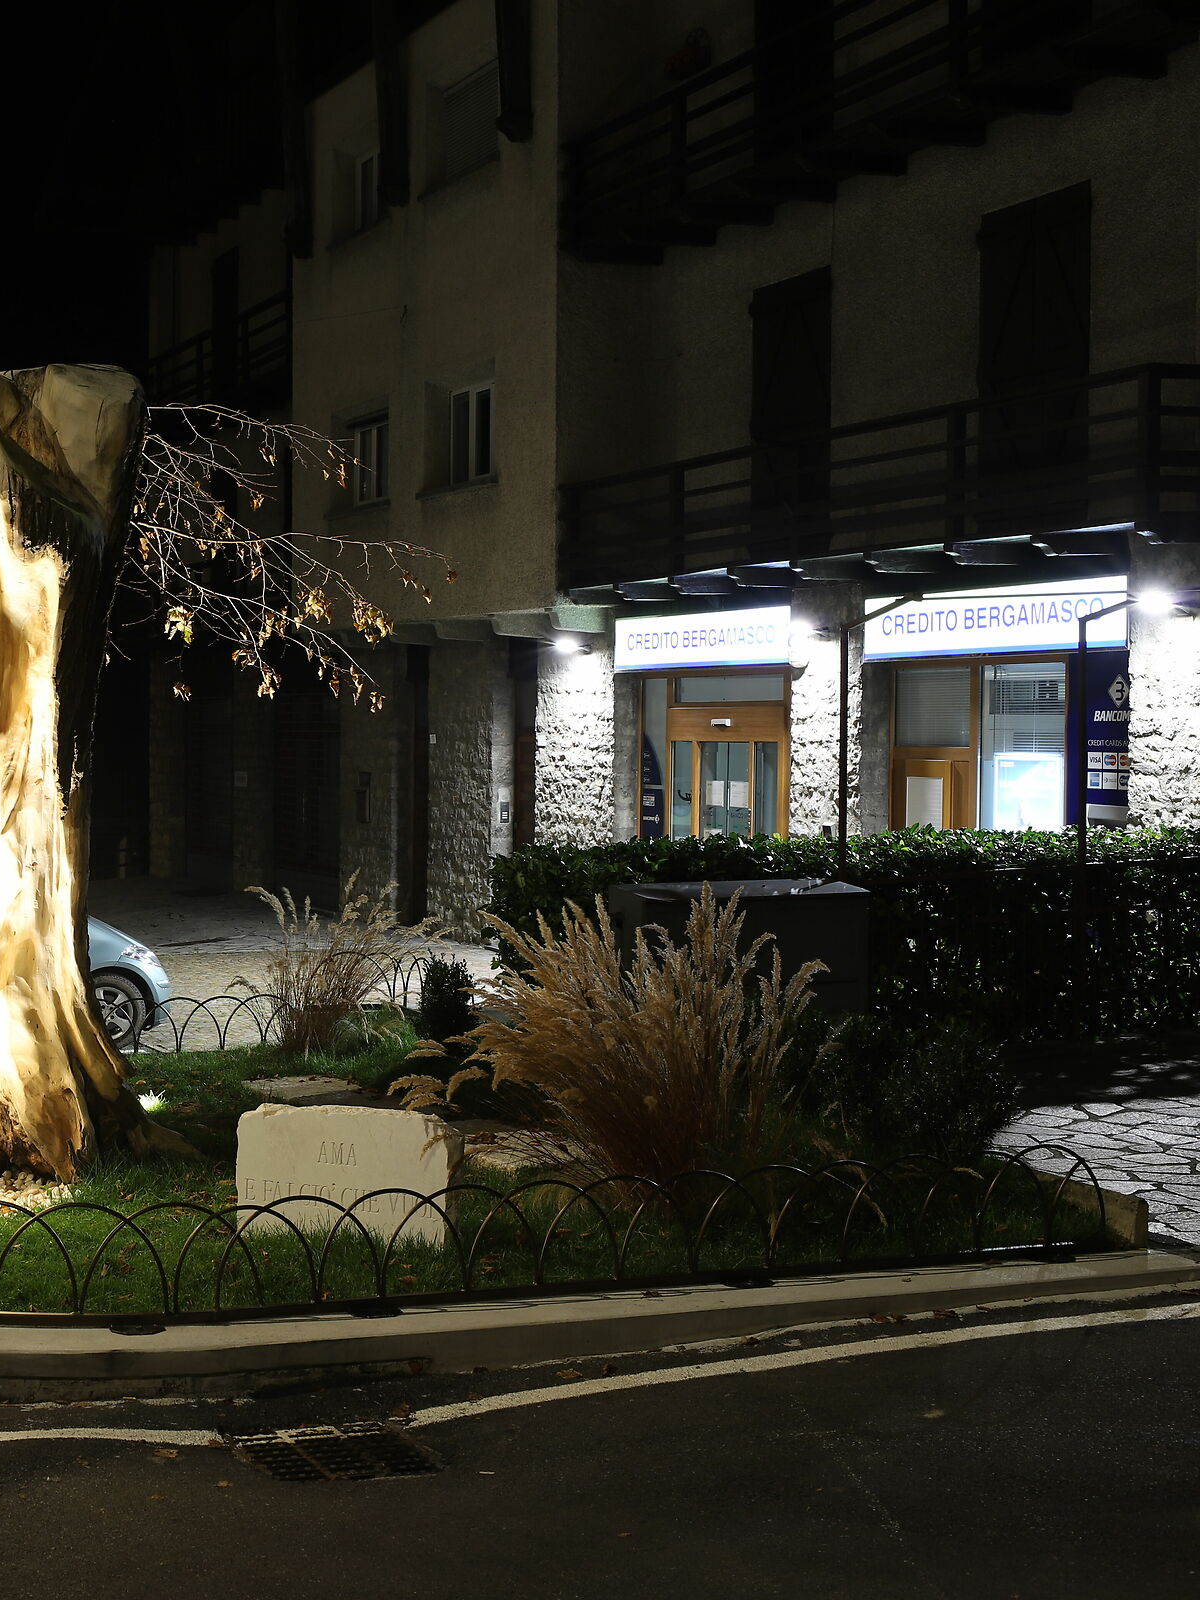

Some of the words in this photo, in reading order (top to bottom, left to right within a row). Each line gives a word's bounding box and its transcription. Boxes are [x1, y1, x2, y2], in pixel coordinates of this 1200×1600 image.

[882, 609, 958, 636] CREDITO
[963, 597, 1104, 630] BERGAMASCO
[627, 631, 679, 651] CREDITO
[682, 625, 776, 648] BERGAMASCO
[1087, 739, 1105, 747] CREDIT
[1105, 740, 1123, 748] CARDS
[1089, 756, 1102, 764] VISA
[316, 1141, 357, 1167] AMA
[245, 1178, 256, 1201] E
[340, 1187, 380, 1214] CHE
